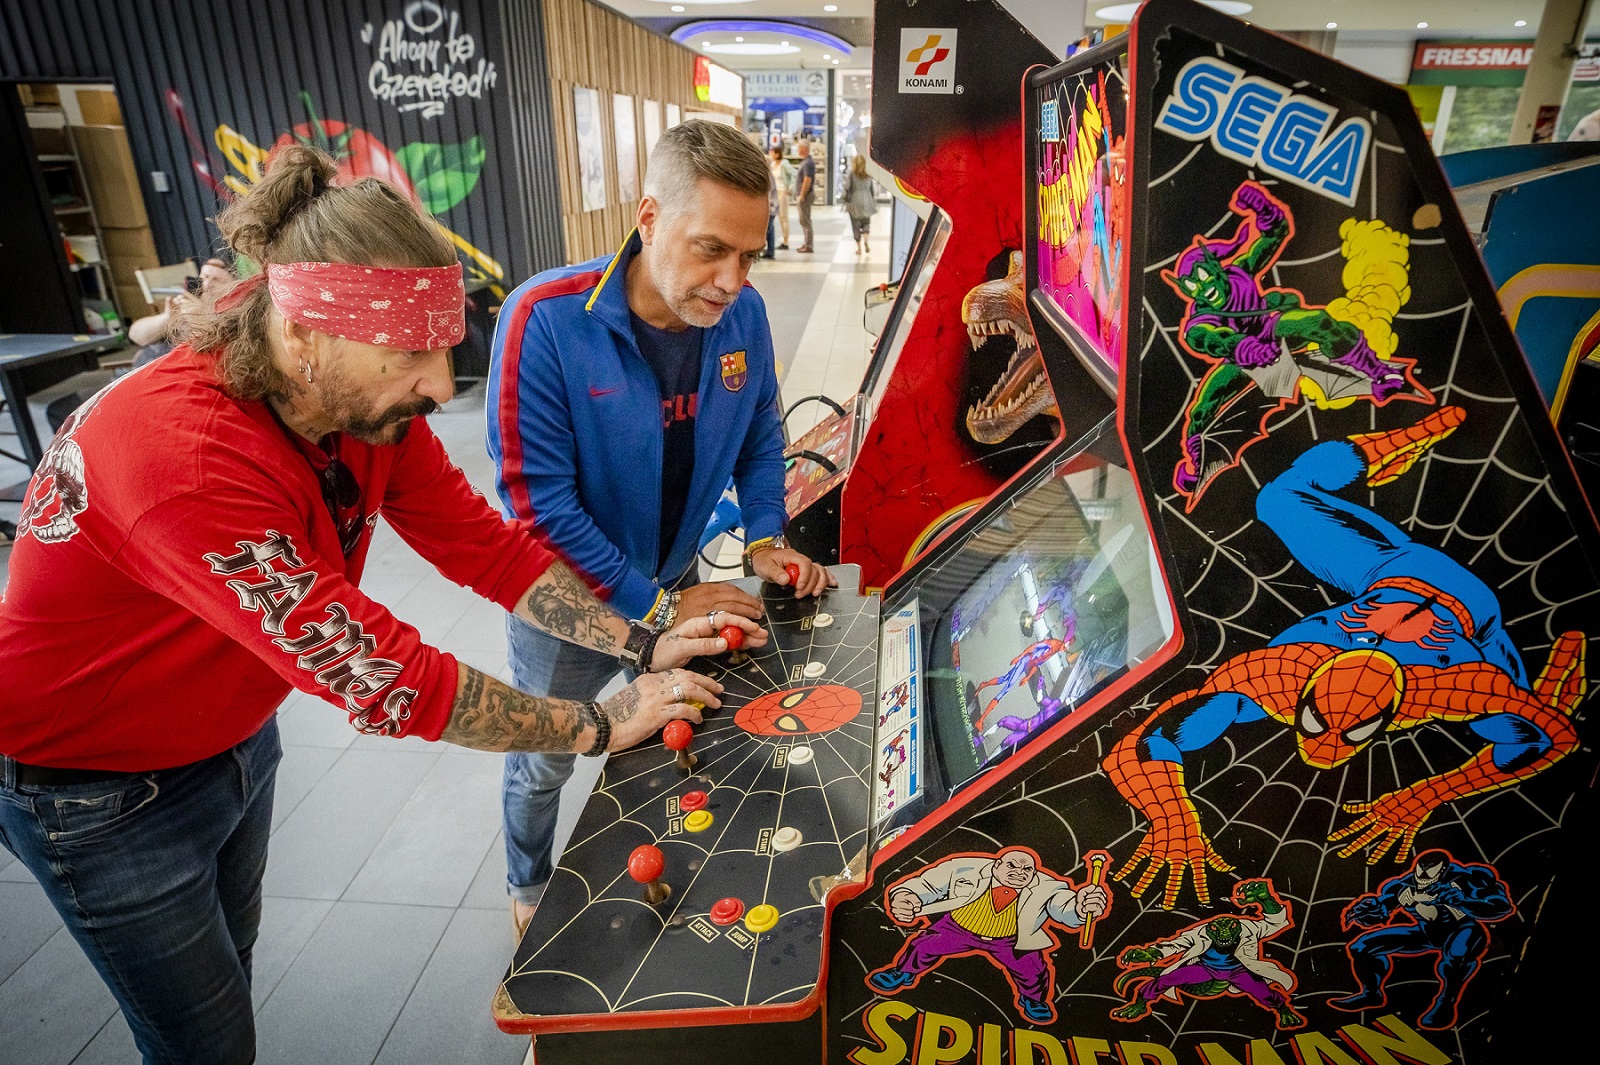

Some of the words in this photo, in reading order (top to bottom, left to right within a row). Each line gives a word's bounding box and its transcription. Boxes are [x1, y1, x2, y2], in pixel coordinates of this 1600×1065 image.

[905, 78, 948, 88] KONAMI
[1155, 57, 1371, 206] SEGA
[694, 922, 714, 939] ATTACK
[731, 930, 749, 944] JUMP
